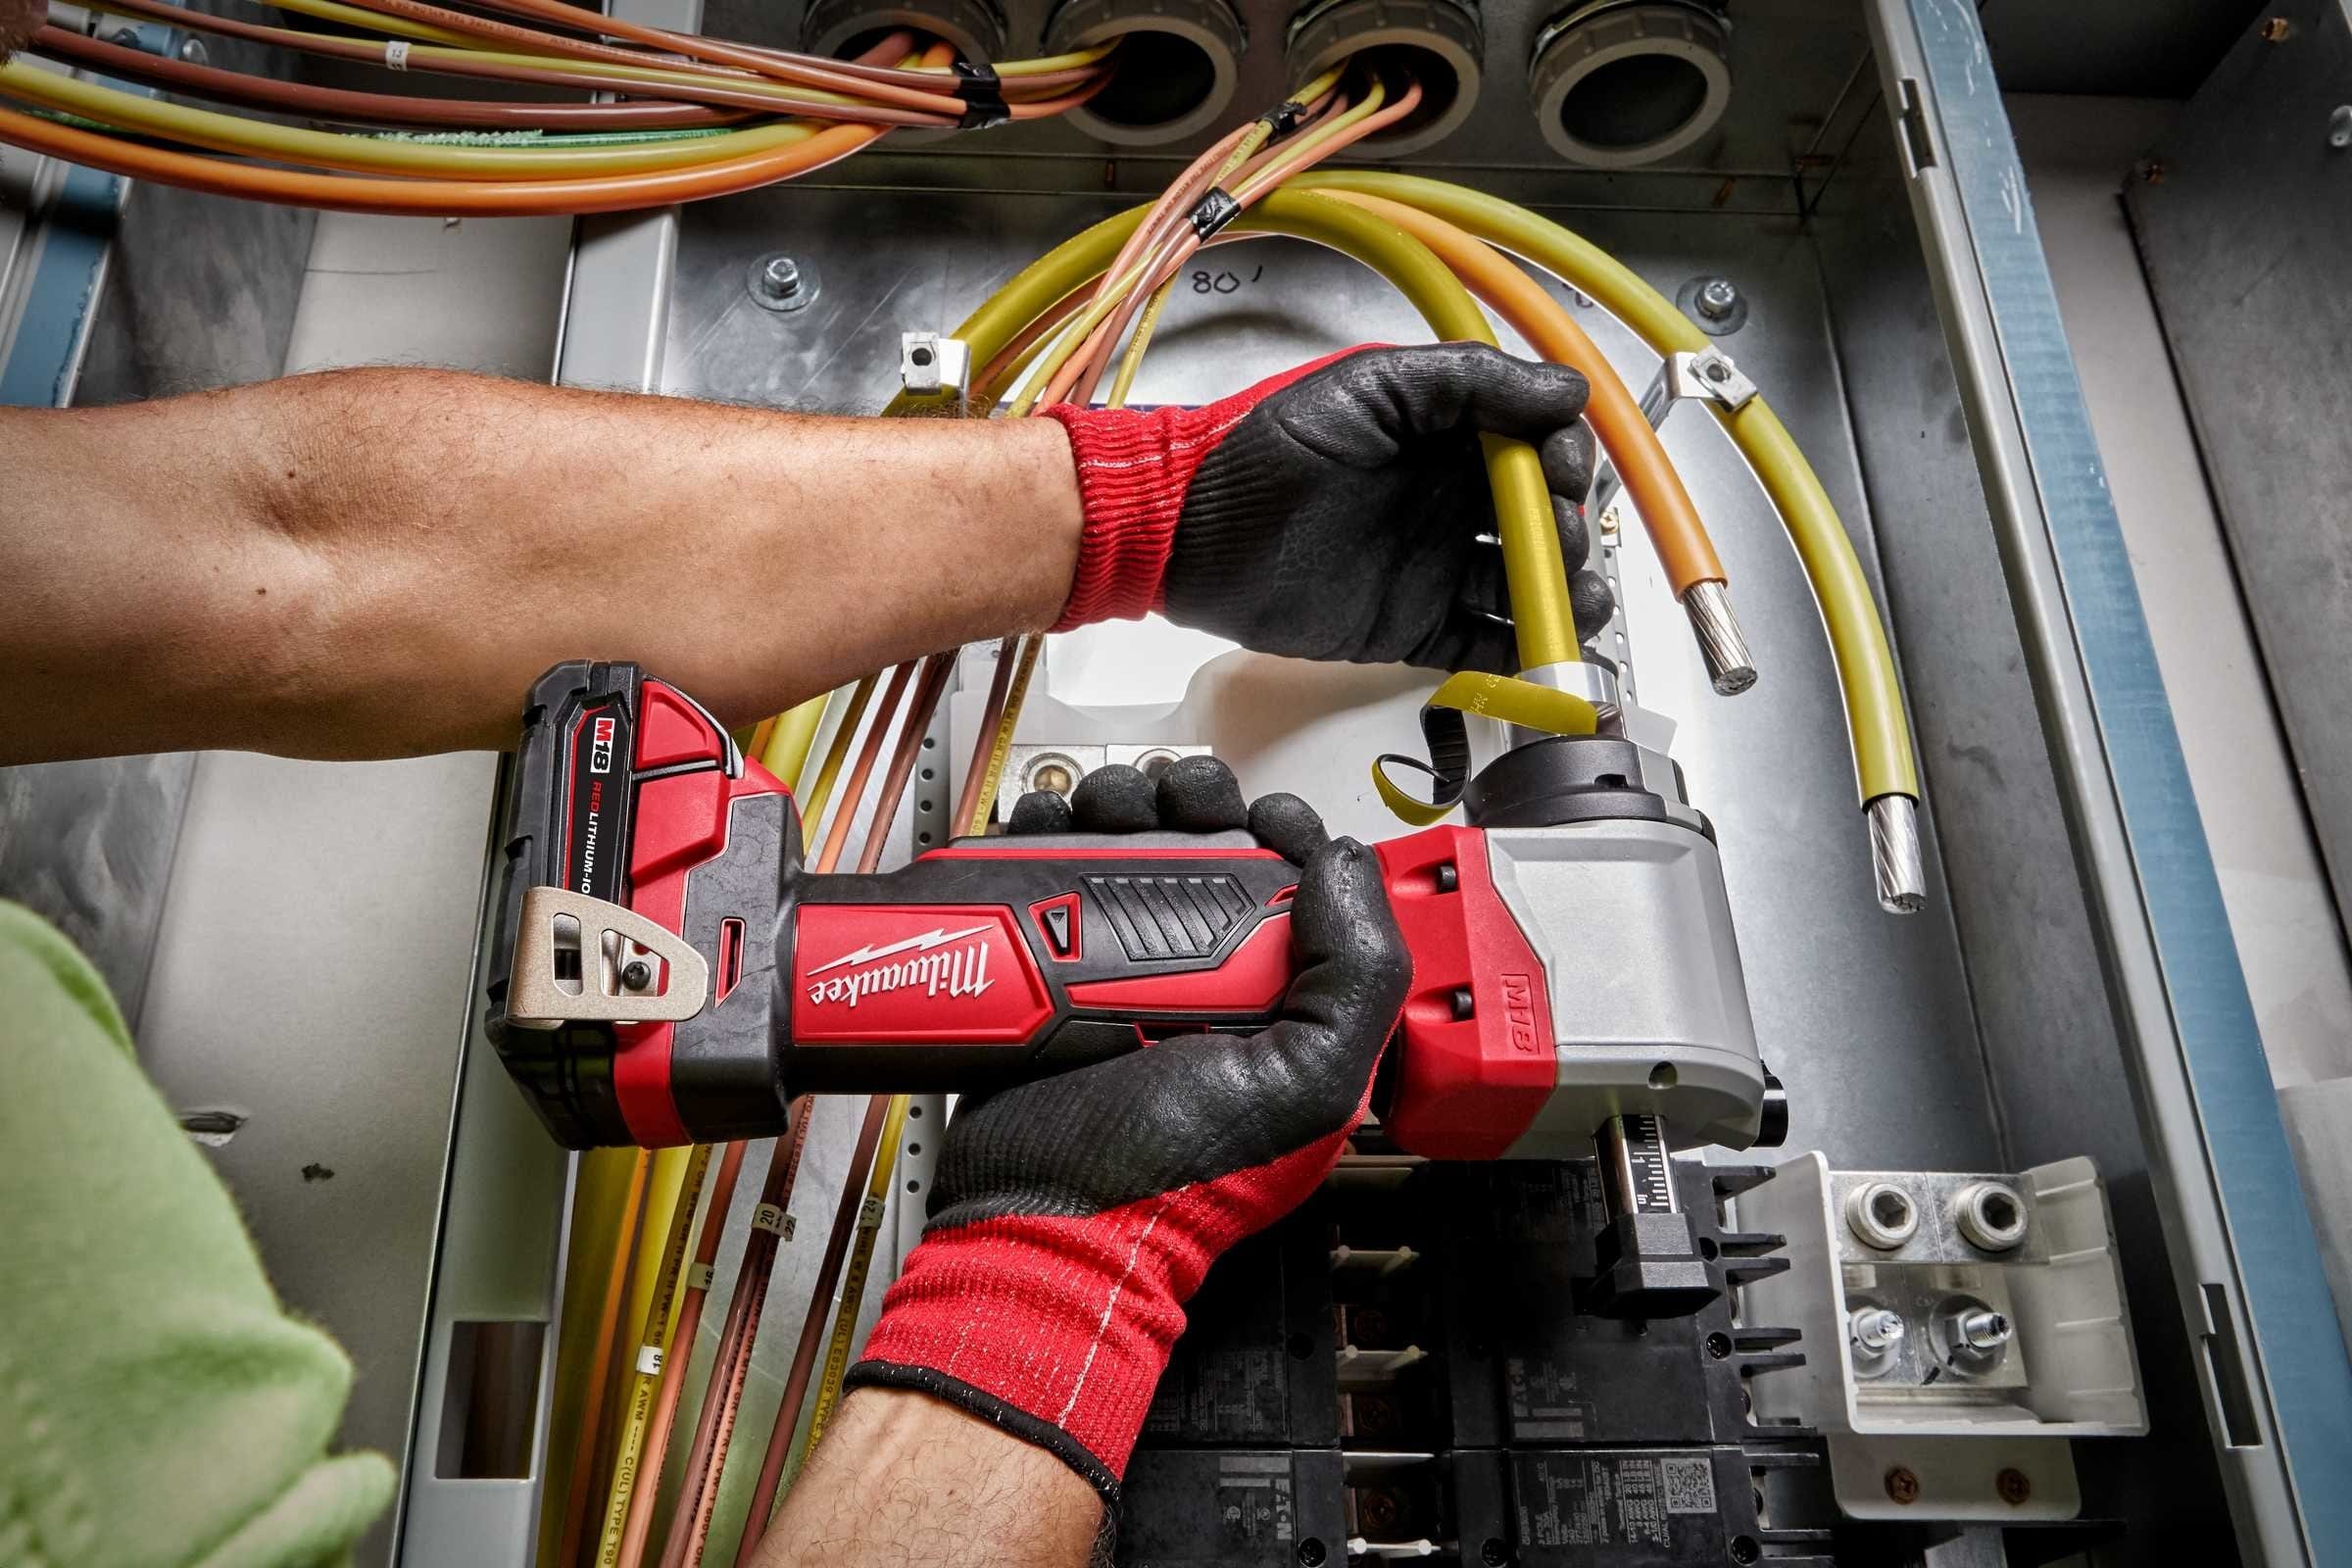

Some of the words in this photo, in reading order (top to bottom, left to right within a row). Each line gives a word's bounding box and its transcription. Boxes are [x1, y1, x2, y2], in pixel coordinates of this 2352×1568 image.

[593, 719, 614, 772] M18
[581, 781, 604, 895] REDLITHIUM-IO
[808, 941, 996, 1008] Milwaukee
[760, 1210, 775, 1226] 20
[835, 1318, 852, 1345] (UL)
[652, 1353, 663, 1369] 18
[634, 1390, 650, 1421] AWM
[609, 1500, 625, 1535] TYPE
[603, 1542, 616, 1565] T90
